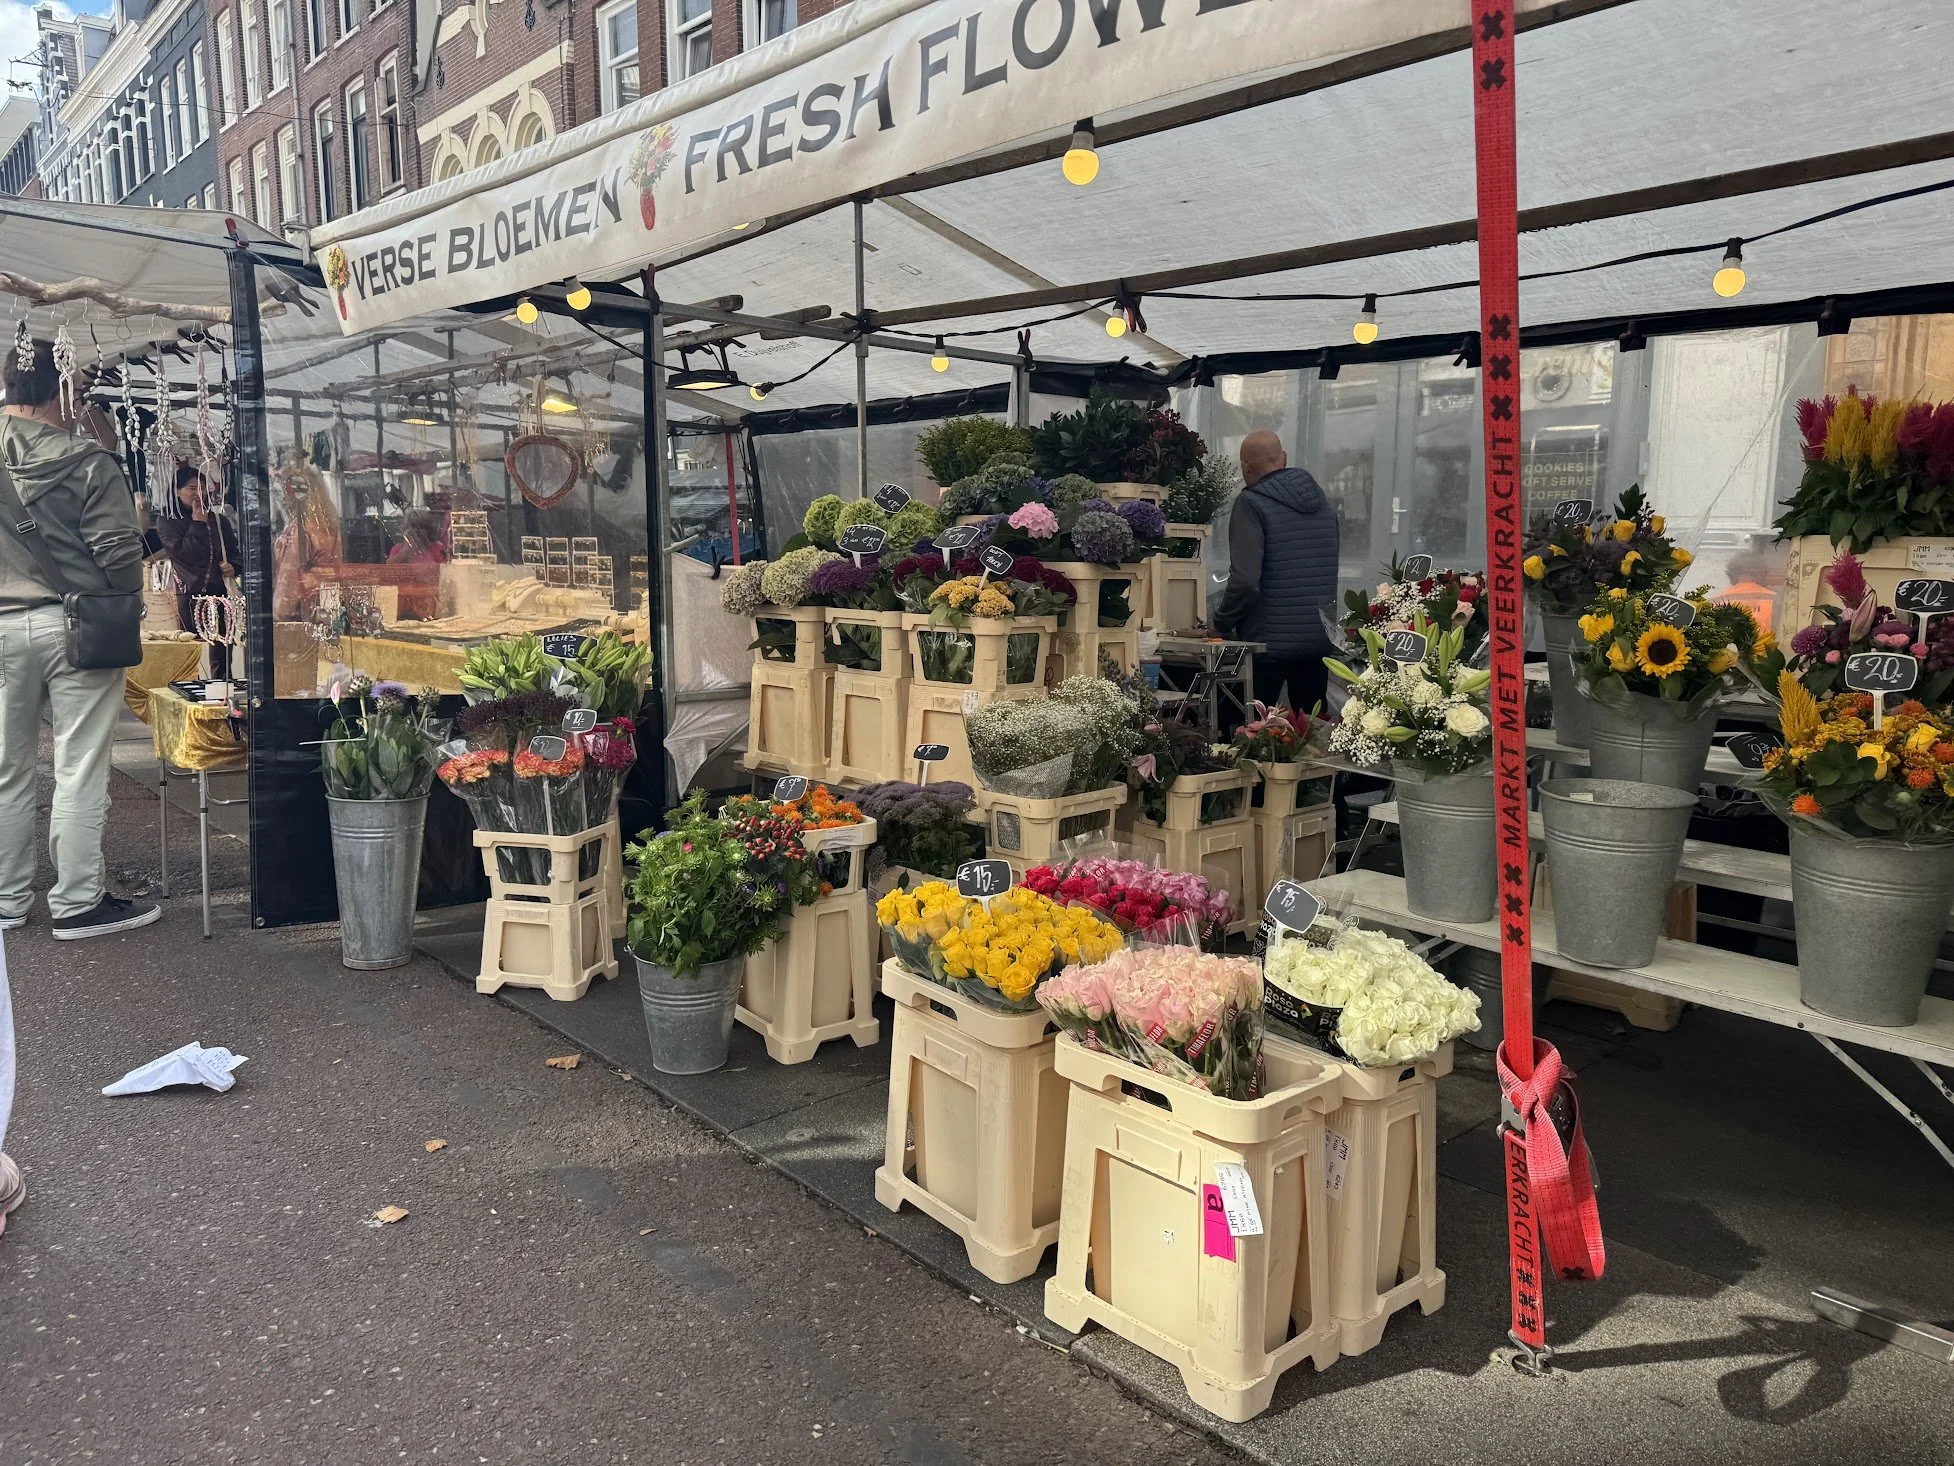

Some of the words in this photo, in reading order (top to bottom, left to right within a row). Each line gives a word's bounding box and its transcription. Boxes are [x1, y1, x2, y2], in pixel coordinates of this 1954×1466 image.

[684, 54, 895, 194] FRESH
[917, 0, 1262, 115] FLOW
[351, 230, 437, 301] VERSE
[447, 165, 623, 275] BLOEMEN
[1523, 477, 1549, 487] OFT
[1551, 475, 1594, 487] SERVE
[1524, 462, 1585, 474] COOKIES
[1528, 489, 1578, 501] COFFEE
[1492, 431, 1516, 655] VEERKRACHT
[1499, 665, 1519, 733] MET
[1500, 740, 1523, 850] MARKT
[1264, 995, 1299, 1018] Plaza
[1265, 986, 1294, 1009] Rosa
[1187, 1023, 1216, 1055] TIMAFLOR
[1511, 1140, 1533, 1268] ERKRACHT
[1227, 1210, 1239, 1233] JMM
